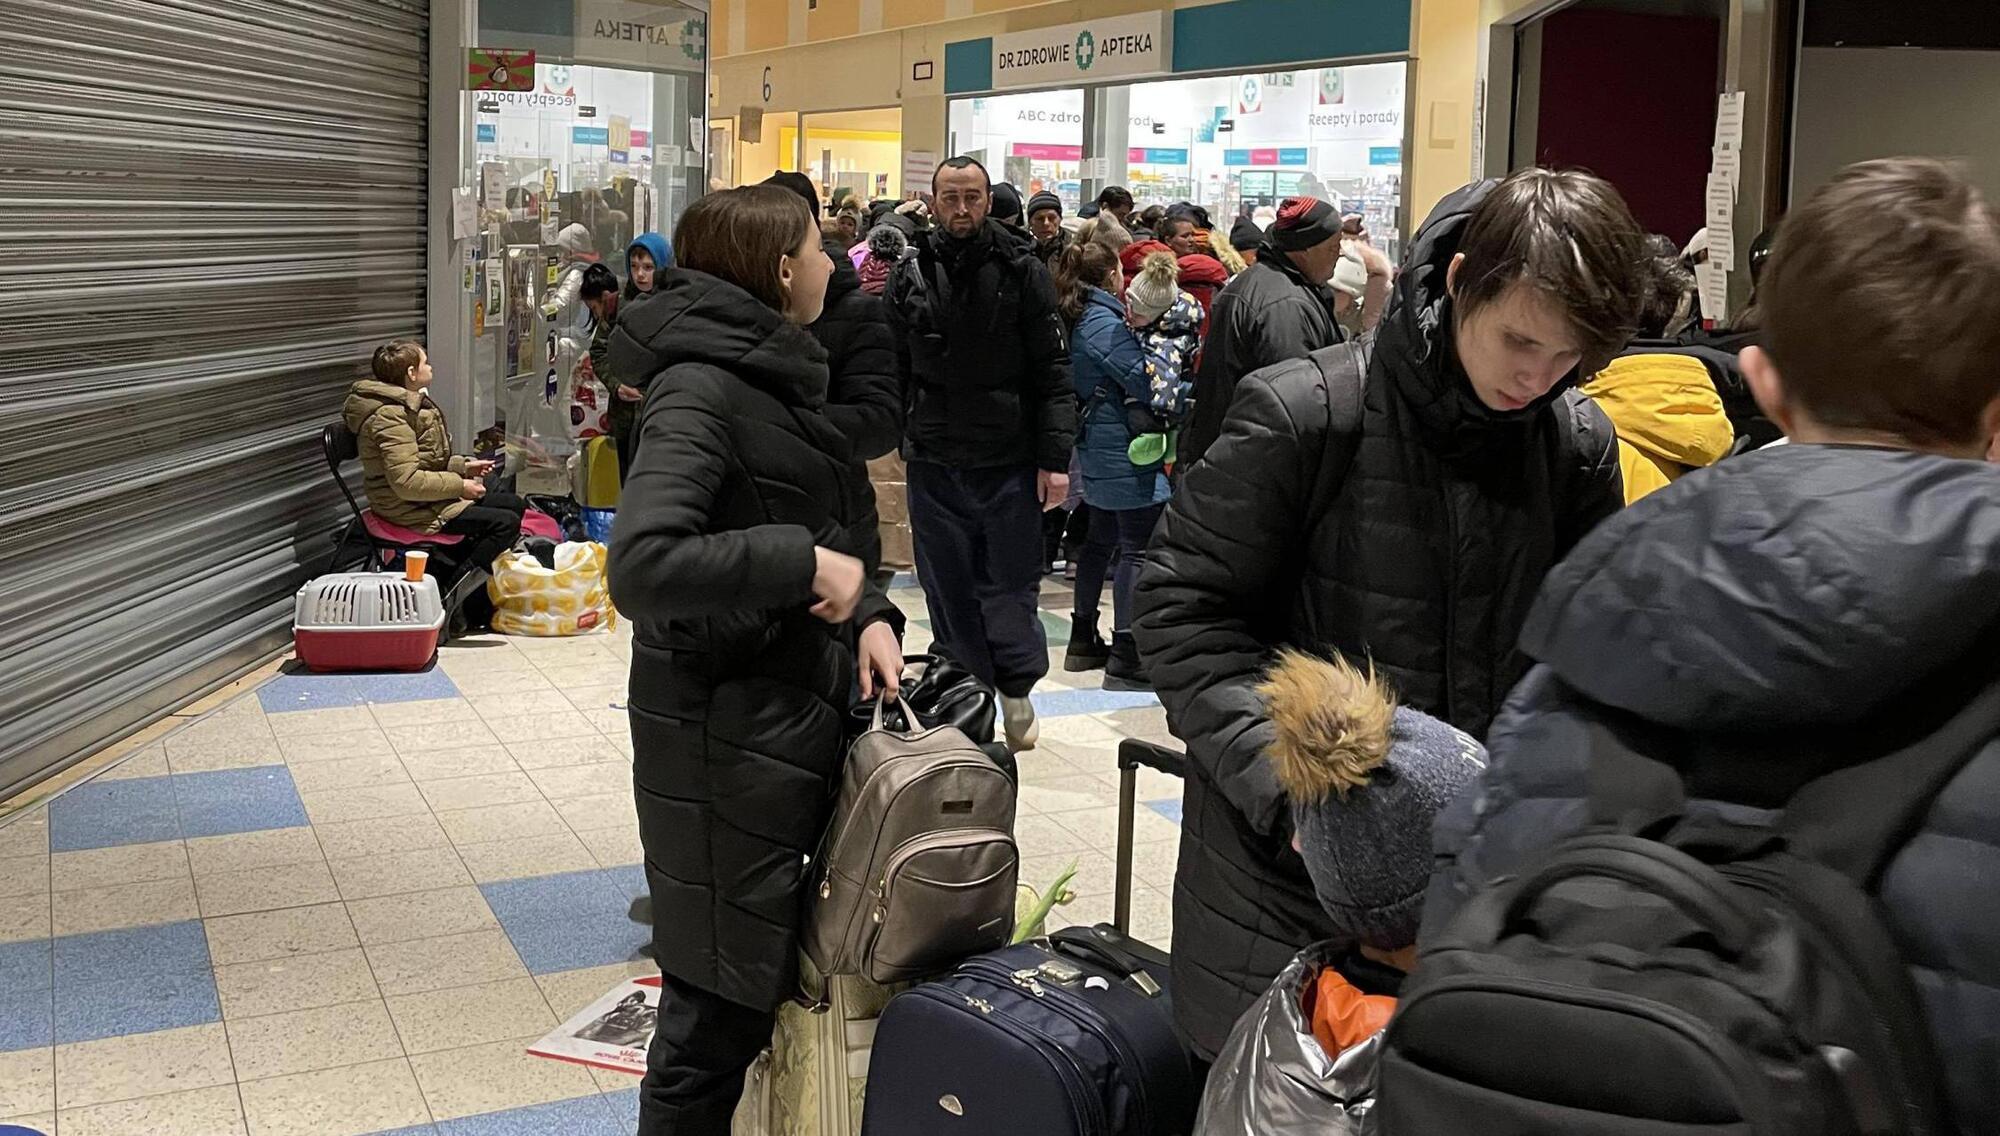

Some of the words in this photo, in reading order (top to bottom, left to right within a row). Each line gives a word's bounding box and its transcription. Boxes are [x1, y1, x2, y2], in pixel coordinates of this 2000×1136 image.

[999, 52, 1014, 69] DR
[1017, 44, 1070, 67] ZDROWIE
[1101, 33, 1152, 57] APTEKA
[763, 66, 771, 102] 6
[1018, 110, 1046, 121] ABC
[1050, 112, 1081, 123] zdro
[1309, 113, 1351, 127] Recepty
[1359, 109, 1399, 126] porady
